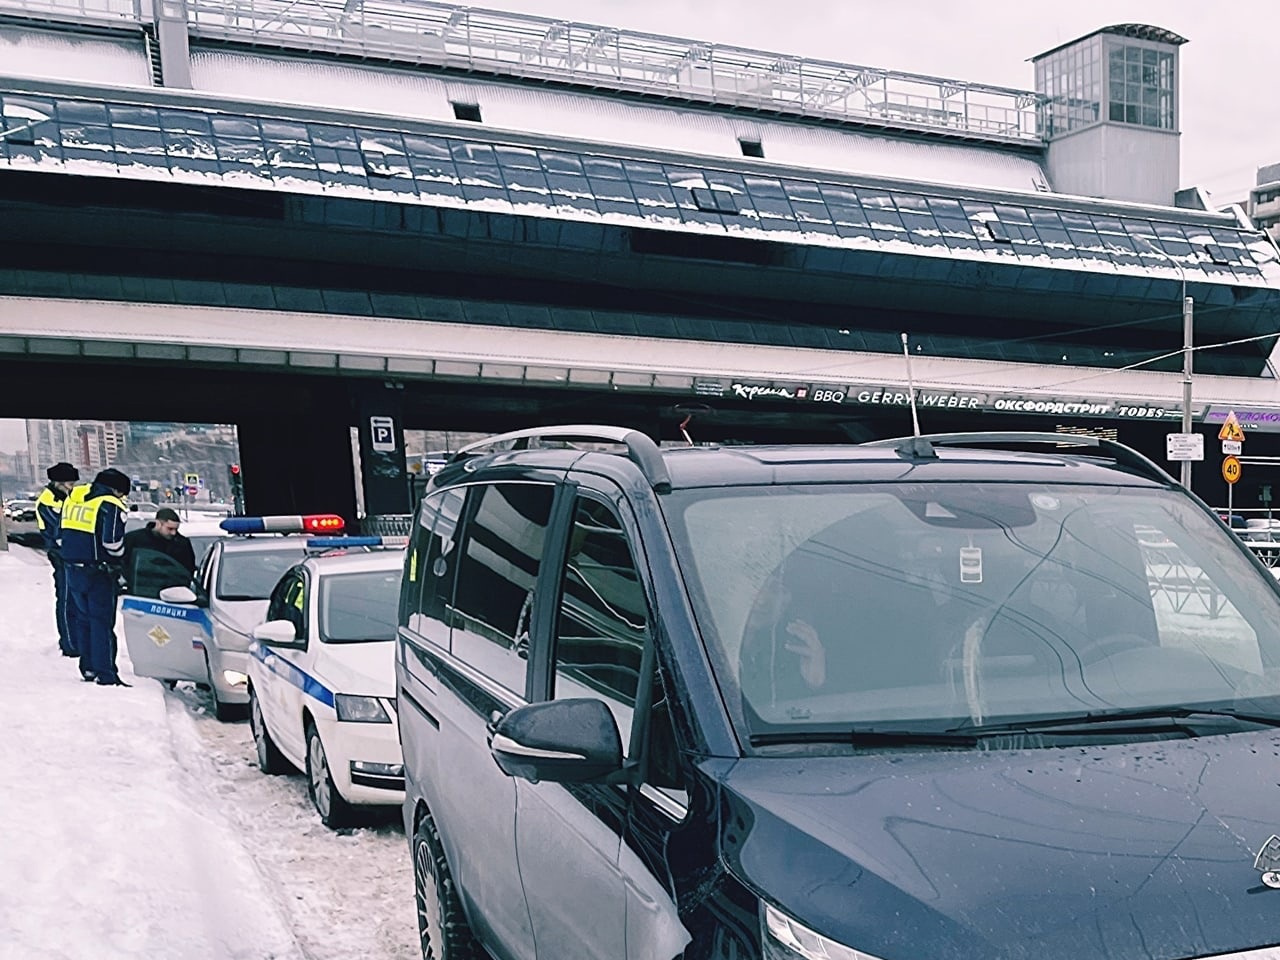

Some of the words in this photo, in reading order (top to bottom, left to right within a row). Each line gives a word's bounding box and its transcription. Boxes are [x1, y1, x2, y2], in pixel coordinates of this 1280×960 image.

[813, 390, 844, 403] BBQ
[857, 391, 913, 405] GERRY
[922, 394, 979, 409] WEBER
[994, 399, 1110, 415] ОКСФОРДСТРИТ
[1118, 406, 1165, 418] TODES
[377, 428, 388, 441] P
[1227, 465, 1238, 475] 40
